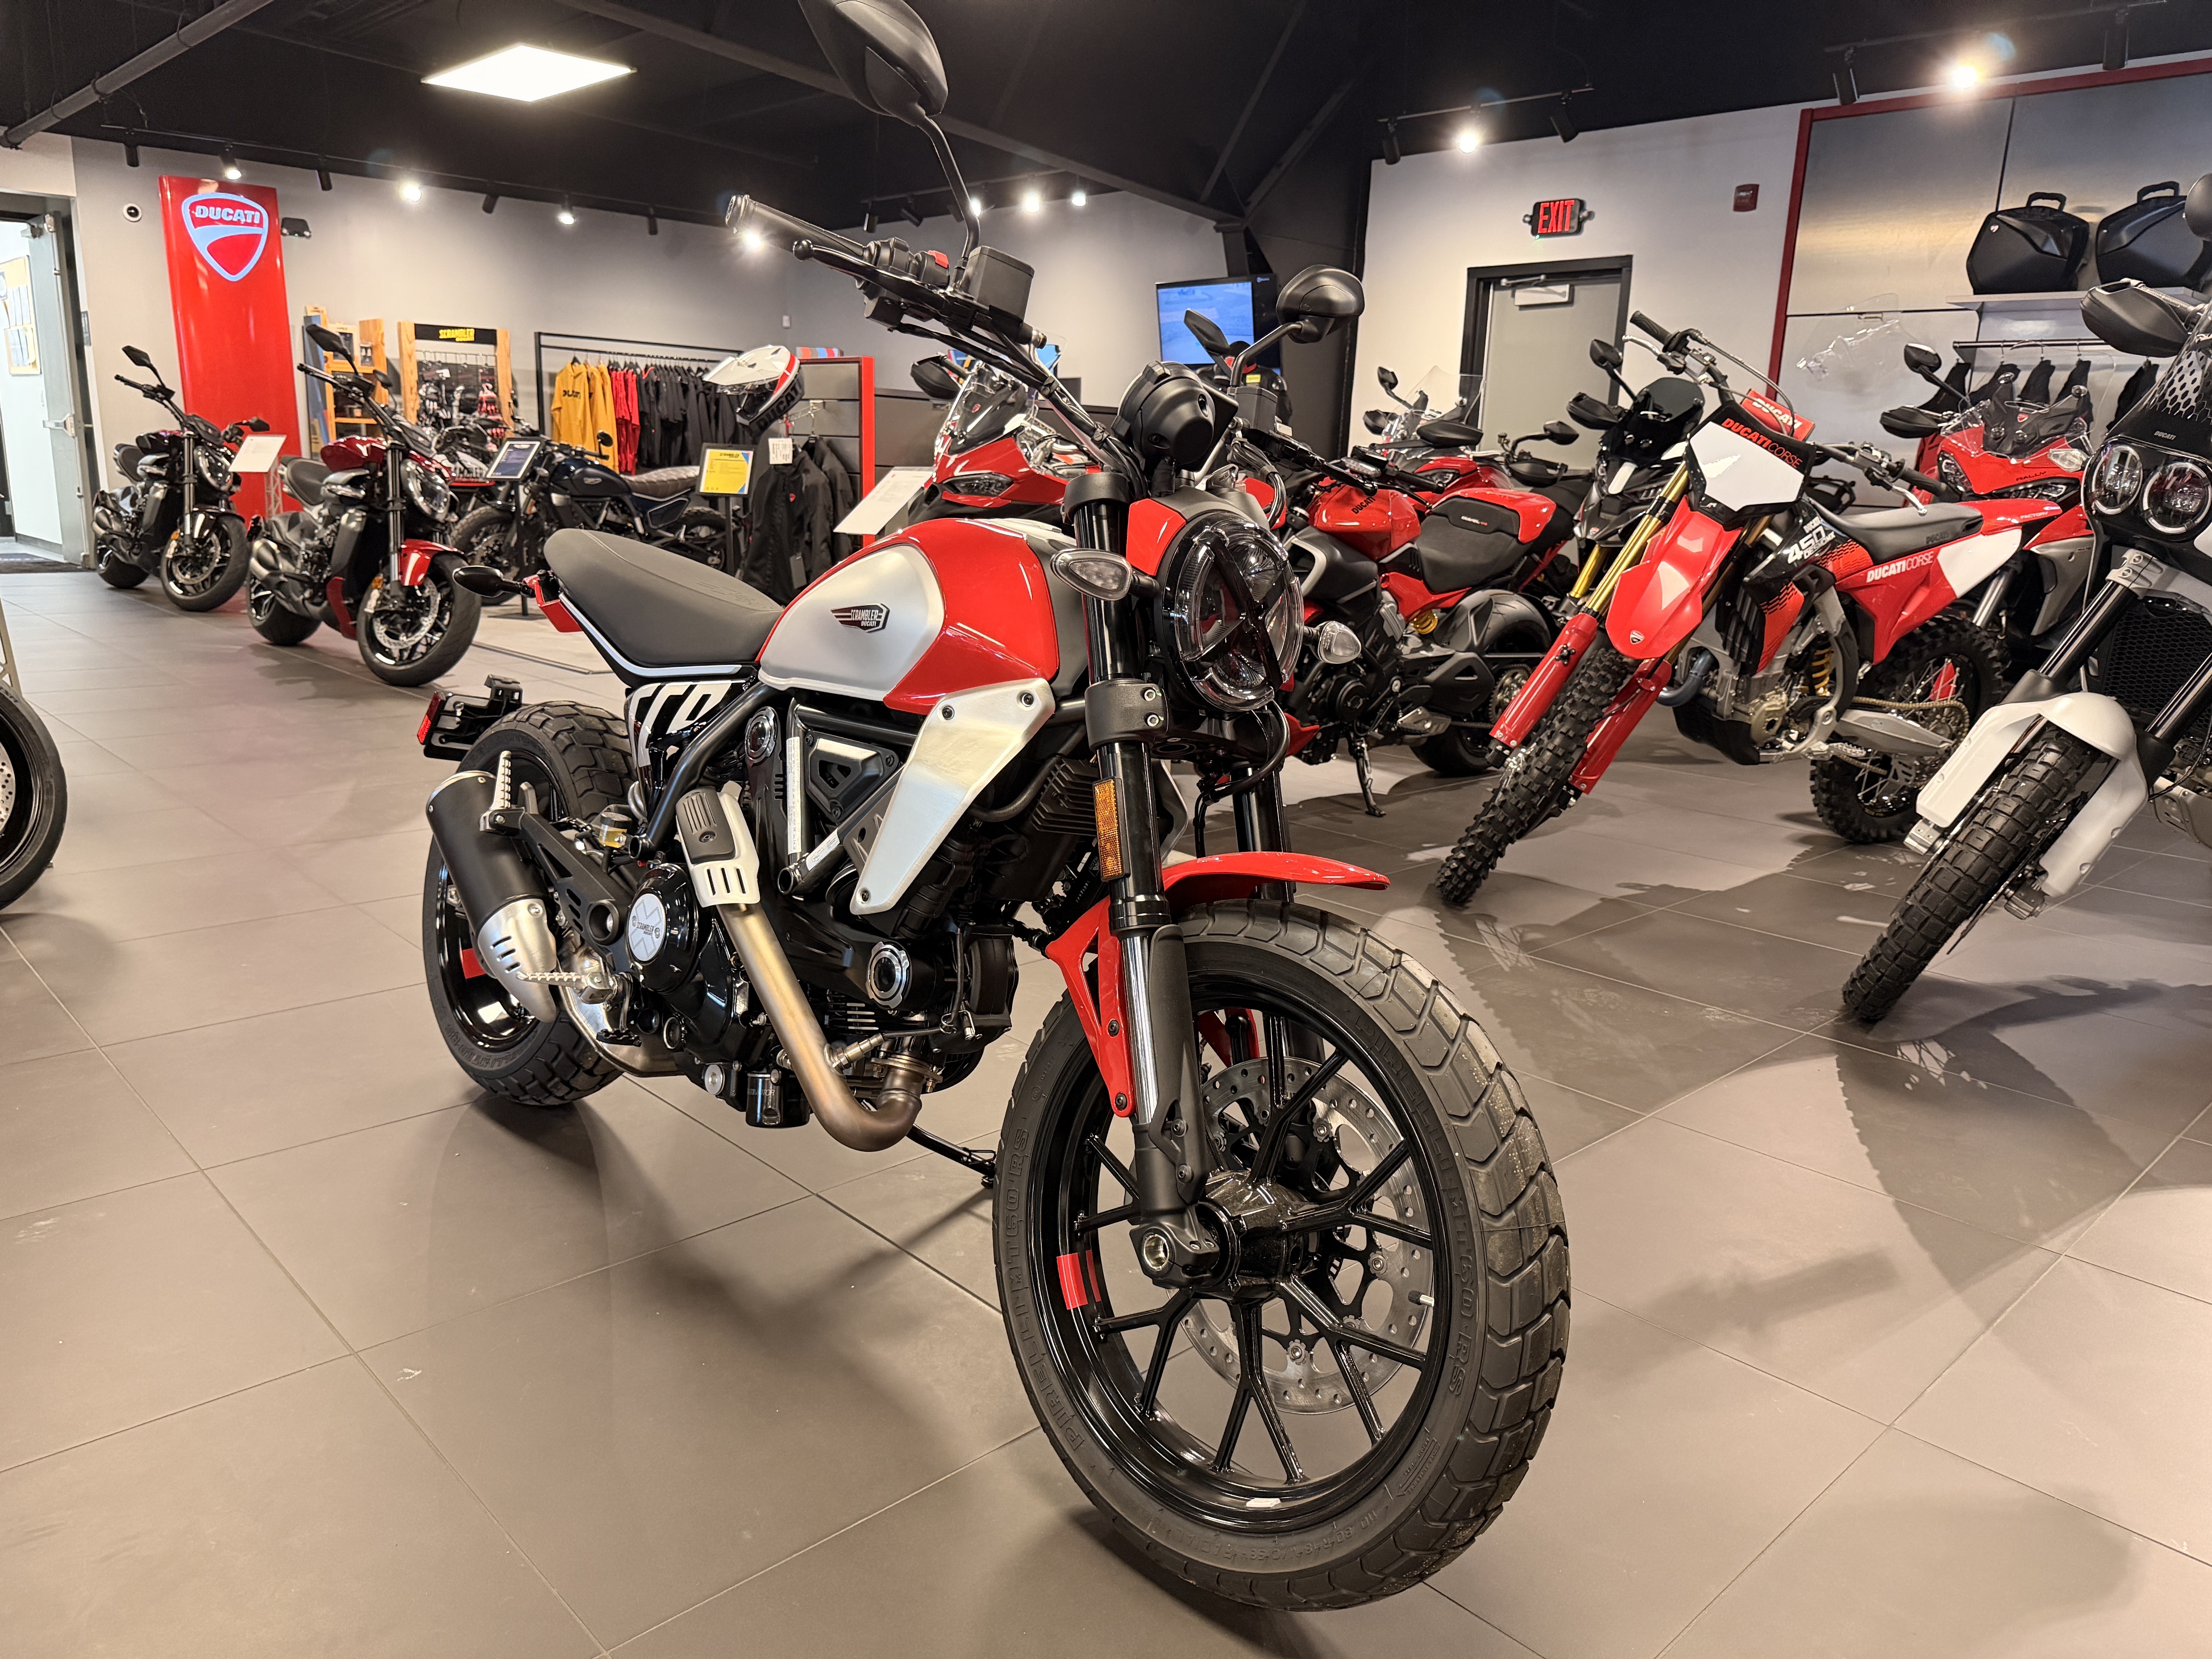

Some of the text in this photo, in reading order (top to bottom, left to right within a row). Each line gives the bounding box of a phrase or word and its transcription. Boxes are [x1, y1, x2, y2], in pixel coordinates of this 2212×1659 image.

[195, 201, 260, 223] DUCATI
[1538, 199, 1575, 234] EXIT
[2154, 431, 2176, 440] DUCATI
[1351, 496, 1376, 514] DUCATI
[1788, 526, 1826, 564] 450
[851, 609, 879, 621] SCRAMBLER
[636, 922, 654, 933] SCRAMBLER
[1008, 1128, 1029, 1176] RS
[1015, 1304, 1084, 1451] PIRELLI
